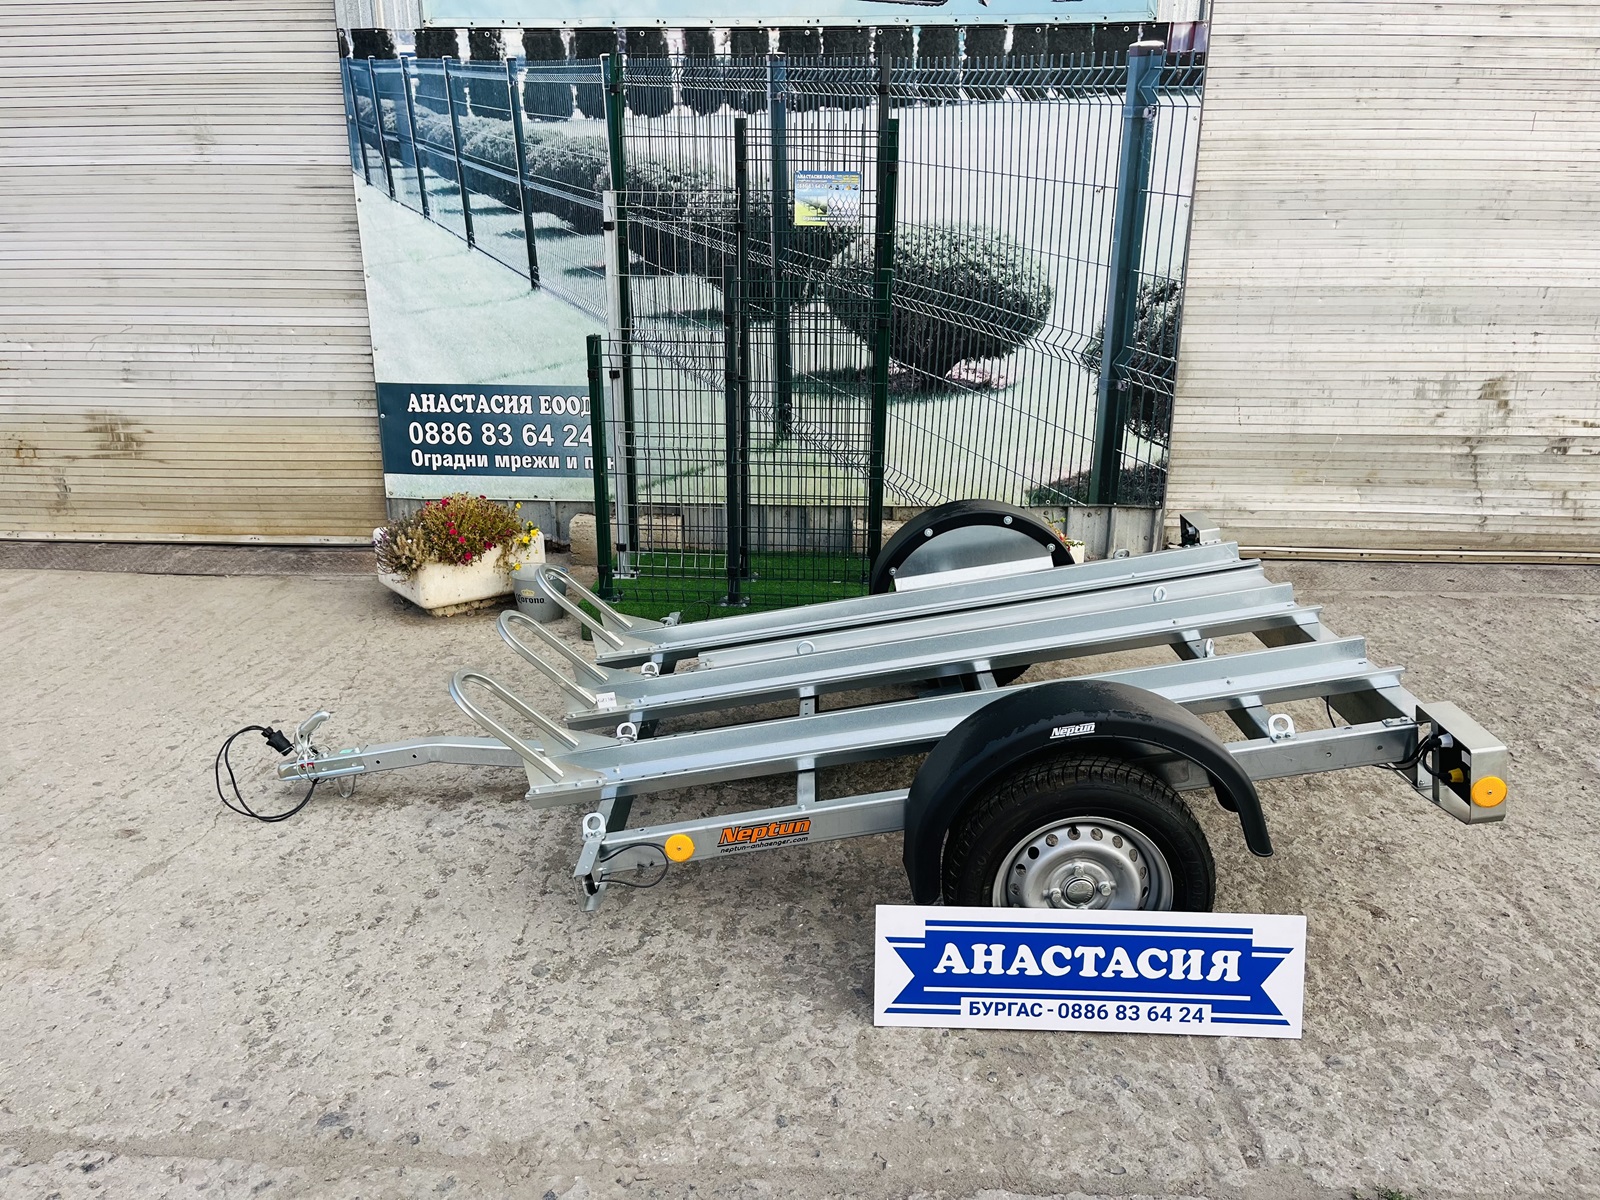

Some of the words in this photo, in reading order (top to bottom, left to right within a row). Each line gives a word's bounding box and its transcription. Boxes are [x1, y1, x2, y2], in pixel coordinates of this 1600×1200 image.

[407, 393, 533, 415] АНАСТАСИЯ
[539, 396, 591, 417] ЕООД
[408, 422, 473, 446] 0886
[481, 423, 513, 446] 83
[522, 423, 554, 447] 64
[562, 424, 592, 448] 24
[411, 449, 488, 470] Оградни
[495, 454, 559, 472] мрежи
[566, 455, 578, 469] и
[1051, 723, 1095, 737] Neptun
[719, 819, 811, 844] Neptun
[720, 836, 808, 853] neptun-anhaenger.com
[933, 942, 1242, 982] АНАСТАСИЯ
[969, 1001, 1043, 1018] БУРГАС
[1058, 1003, 1108, 1021] 0886
[1115, 1004, 1141, 1022] 83
[1147, 1005, 1172, 1023] 64
[1178, 1006, 1205, 1024] 24
